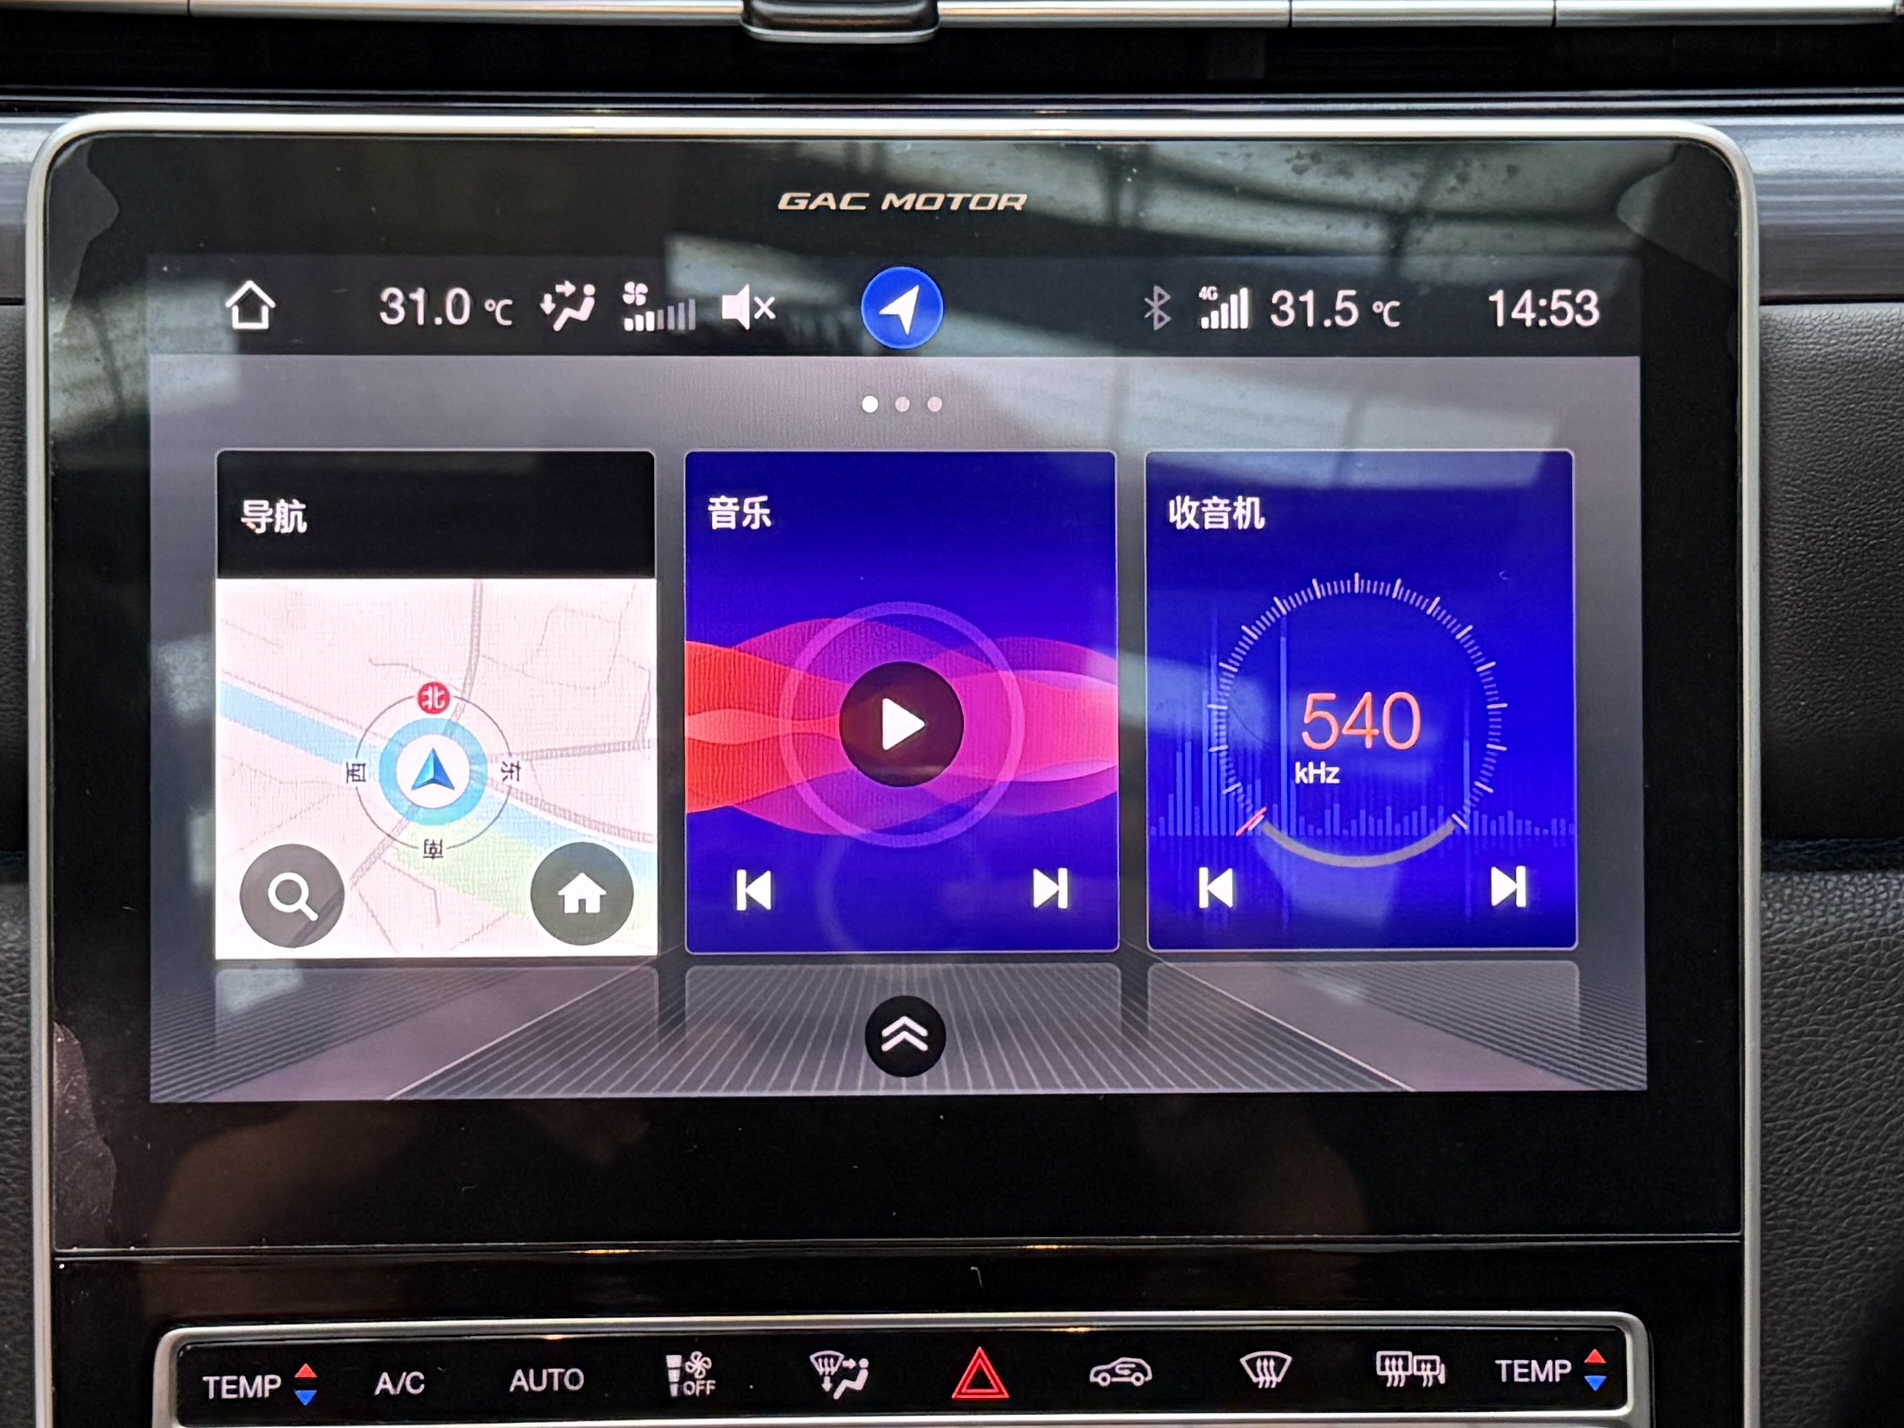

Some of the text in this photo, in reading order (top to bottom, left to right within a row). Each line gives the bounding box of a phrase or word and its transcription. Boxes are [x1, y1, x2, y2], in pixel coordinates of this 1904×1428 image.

[777, 192, 1029, 212] GAC MOTOR
[1198, 285, 1219, 302] 4G
[379, 286, 472, 327] 31.0
[1269, 288, 1360, 328] 31.5
[1487, 288, 1601, 328] 14:53
[240, 499, 309, 535] 导航
[707, 495, 772, 531] 音乐
[1168, 495, 1266, 532] 收音机
[422, 686, 446, 709] 北
[1301, 691, 1421, 750] 540
[500, 760, 522, 782] 东
[1294, 761, 1341, 785] kHz
[422, 839, 444, 860] 南
[509, 1369, 585, 1392] AUTO
[1495, 1359, 1572, 1383] TEMP
[202, 1375, 282, 1399] TEMP
[374, 1372, 425, 1396] A/C
[683, 1379, 716, 1397] OFF
